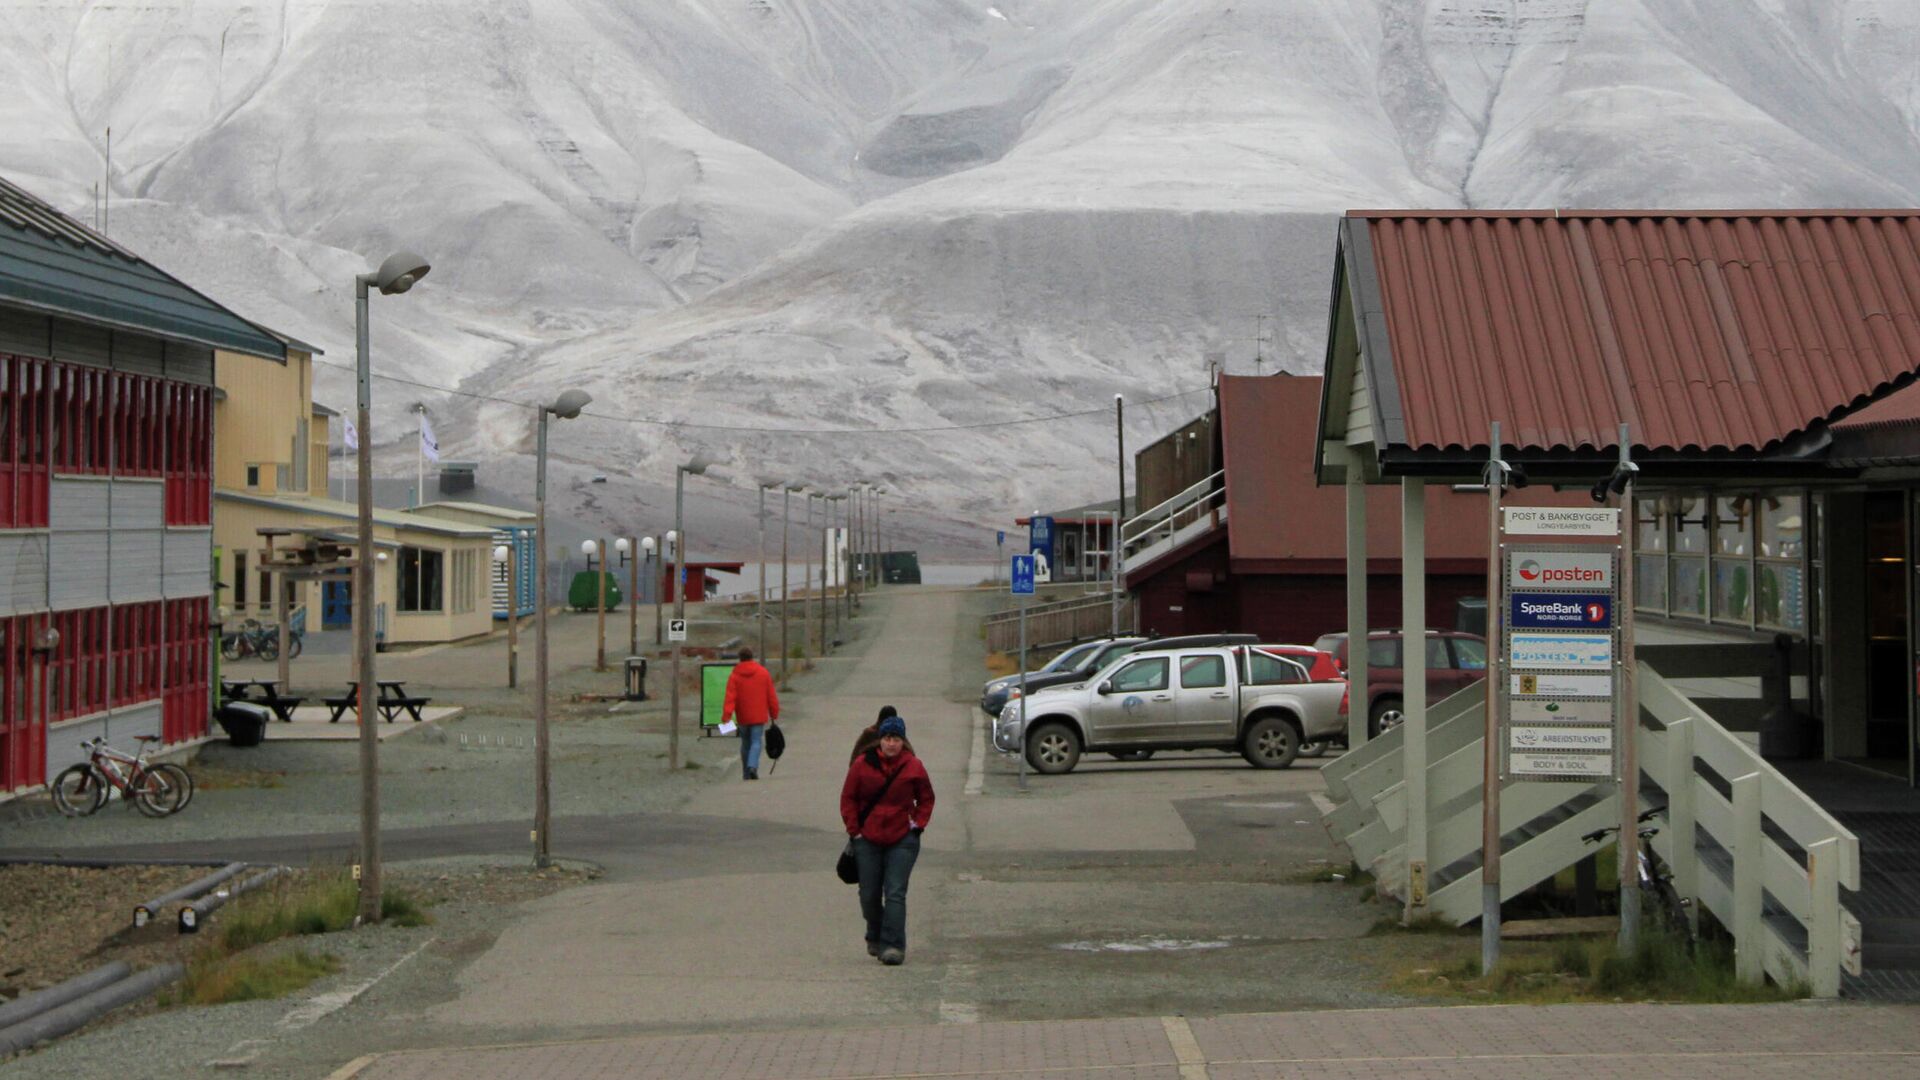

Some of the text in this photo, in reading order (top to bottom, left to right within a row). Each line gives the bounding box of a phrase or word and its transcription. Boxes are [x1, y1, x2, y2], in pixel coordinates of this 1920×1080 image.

[1511, 512, 1610, 522] POST & BANKBYGGET
[1542, 567, 1603, 584] posten
[1521, 602, 1582, 614] SpareBank
[1533, 760, 1556, 769] BODY
